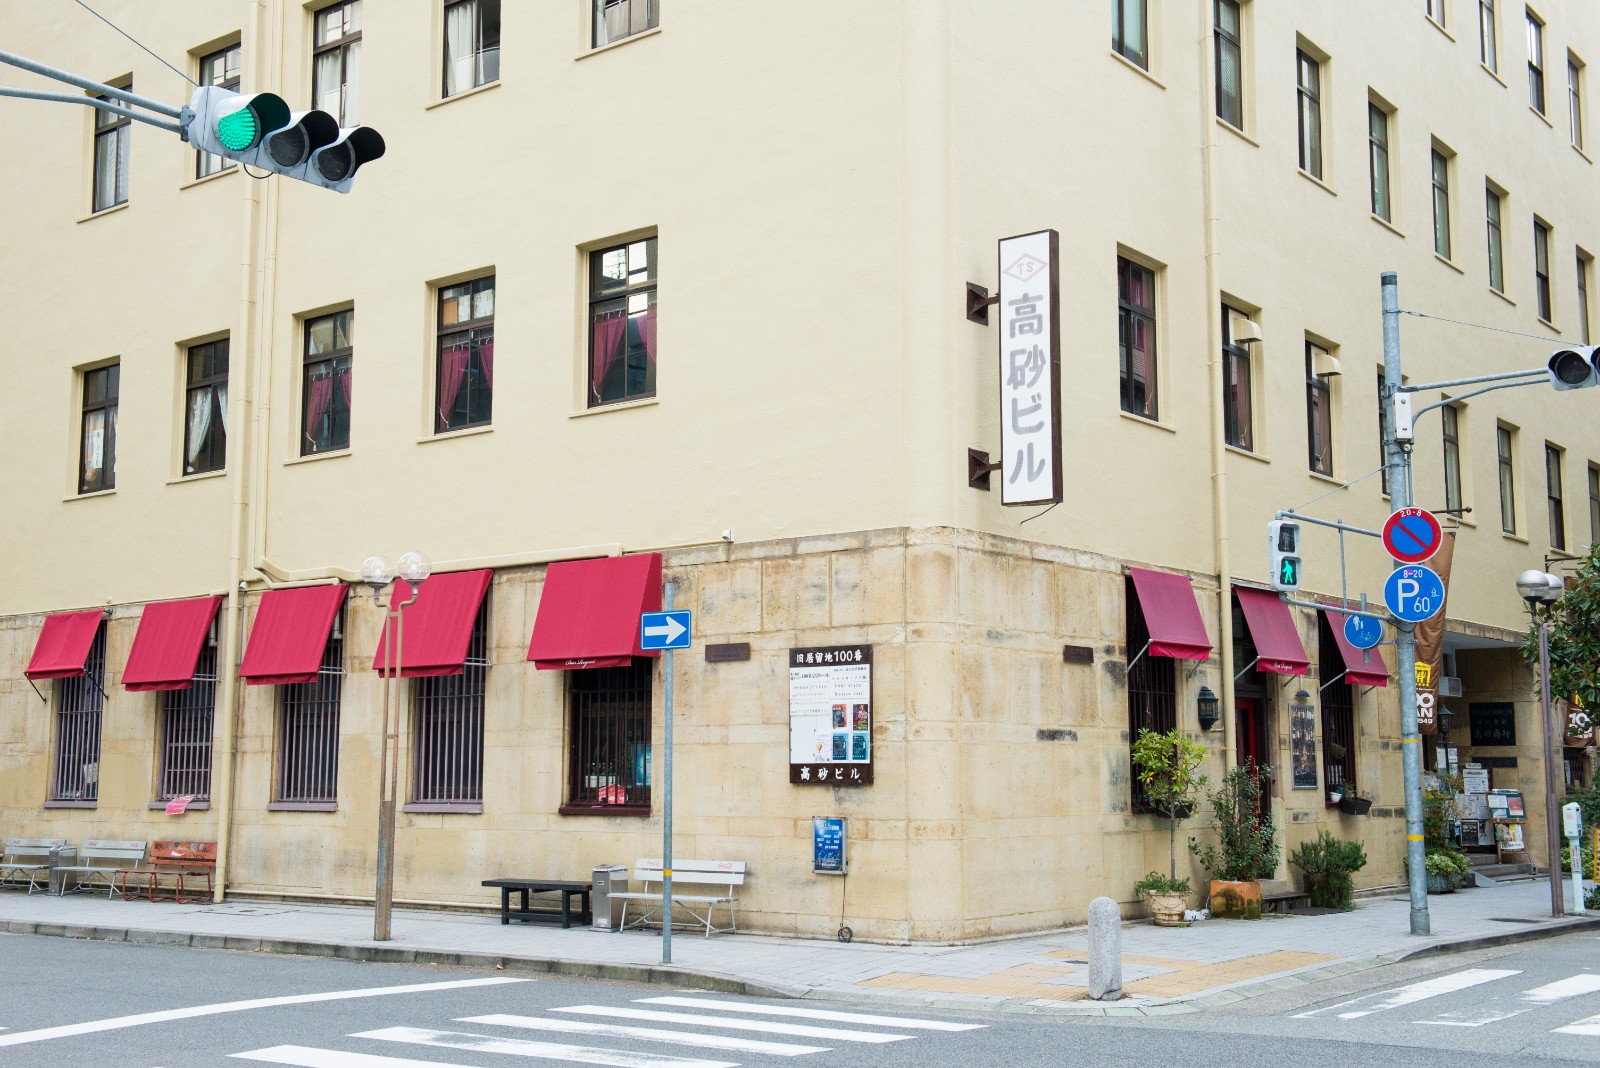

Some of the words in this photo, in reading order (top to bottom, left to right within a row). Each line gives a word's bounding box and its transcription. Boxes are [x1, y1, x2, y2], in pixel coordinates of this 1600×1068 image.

[1017, 261, 1034, 276] TS
[1006, 292, 1046, 484] 高砂ビル
[1400, 509, 1422, 517] 20-8
[1403, 569, 1423, 579] 8-20
[1398, 579, 1420, 613] P
[1413, 597, 1430, 613] 60
[796, 649, 862, 664] 旧居留地100番
[800, 766, 861, 781] 高砂ビル
